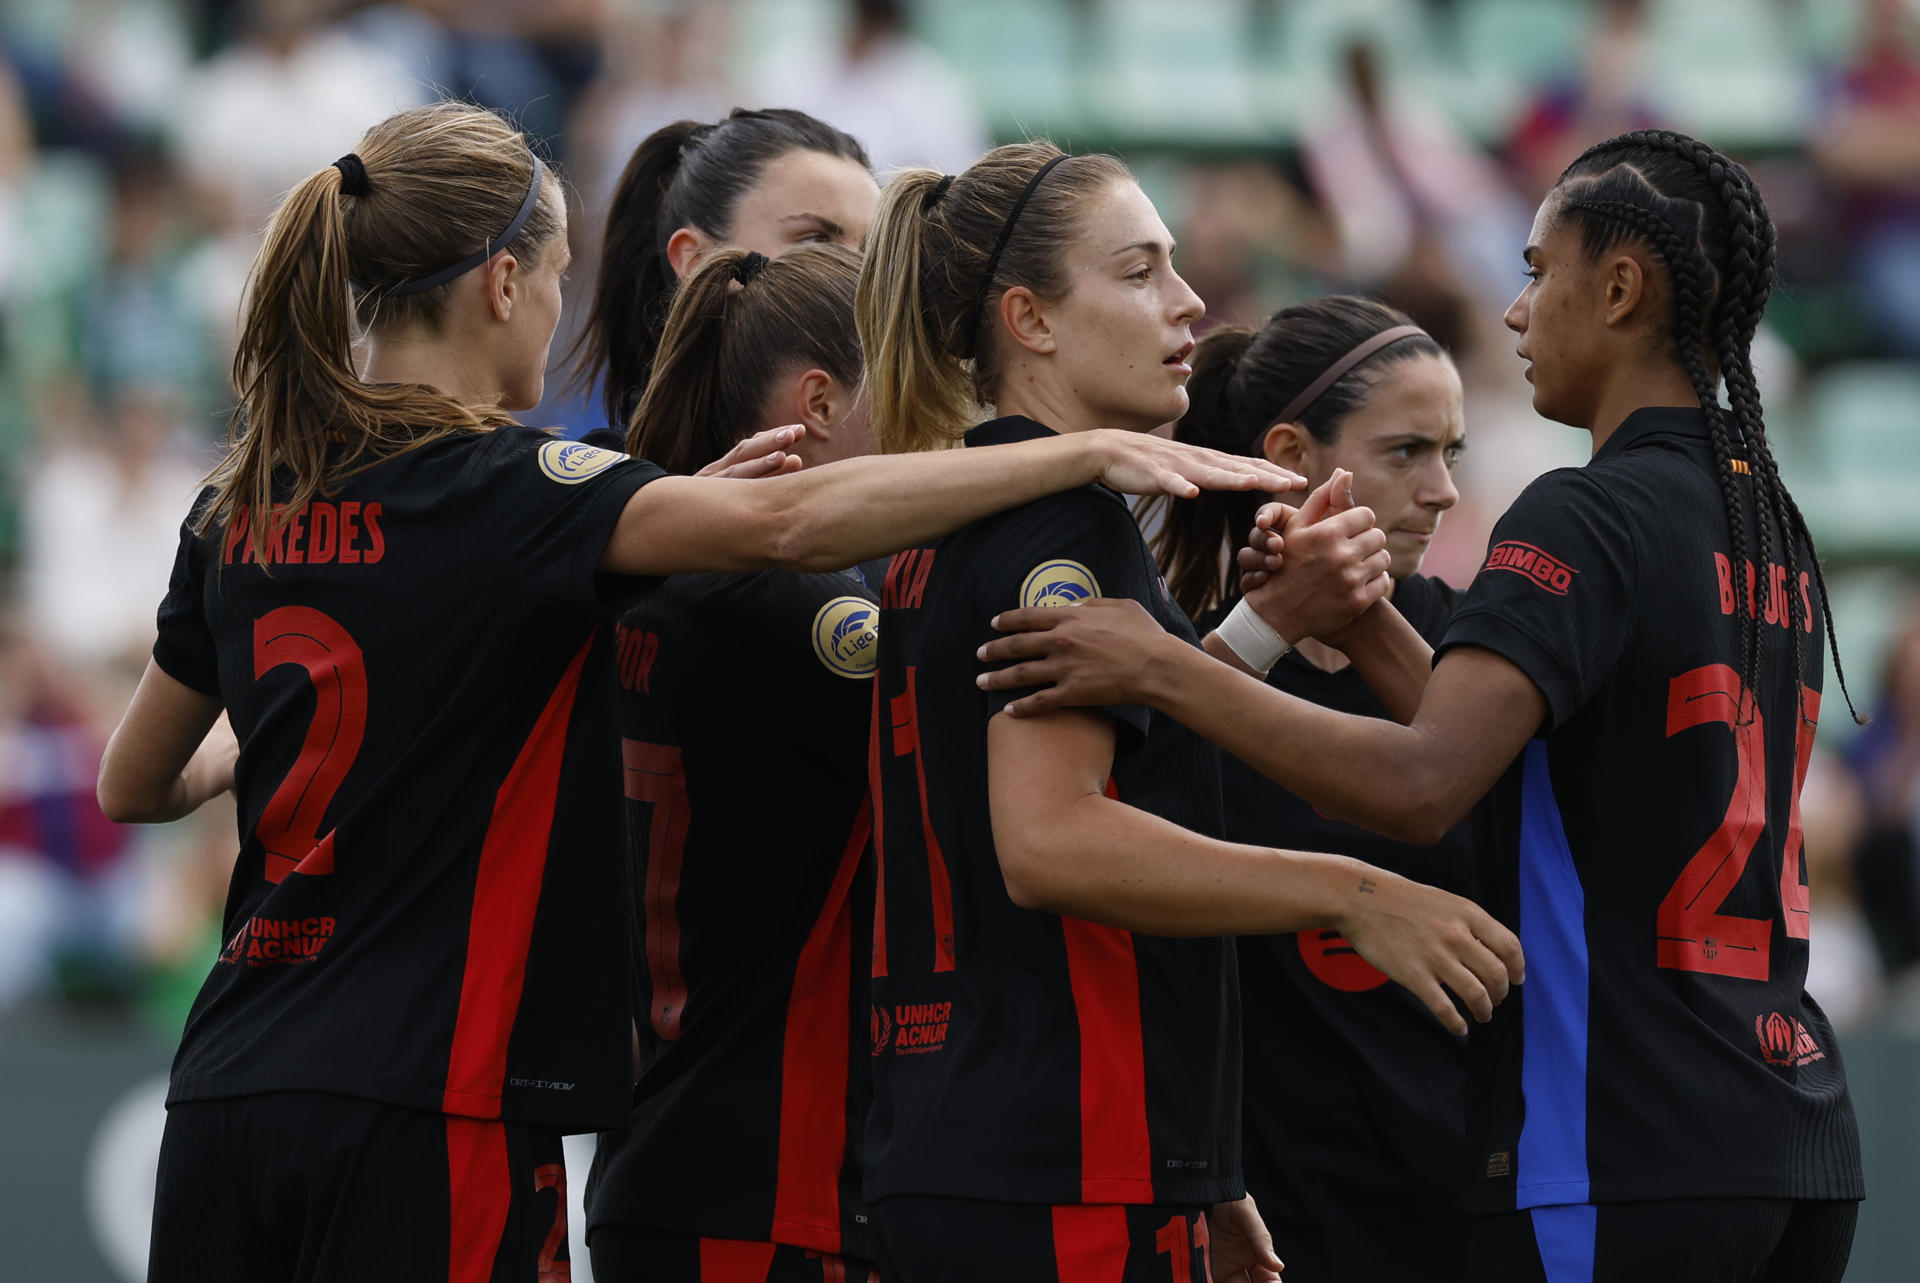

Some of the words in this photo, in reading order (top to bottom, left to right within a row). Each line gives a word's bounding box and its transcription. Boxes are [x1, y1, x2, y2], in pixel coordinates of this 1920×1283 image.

[224, 501, 387, 564] PAREDES
[1486, 547, 1572, 590] BIMBO
[1714, 552, 1813, 633] BRUGS
[254, 605, 368, 884] 2
[250, 917, 336, 939] UNHCR
[895, 1023, 949, 1047] ACNUR
[896, 1001, 952, 1025] UNHCR
[534, 1163, 571, 1283] 2
[1156, 1210, 1214, 1283] 11
